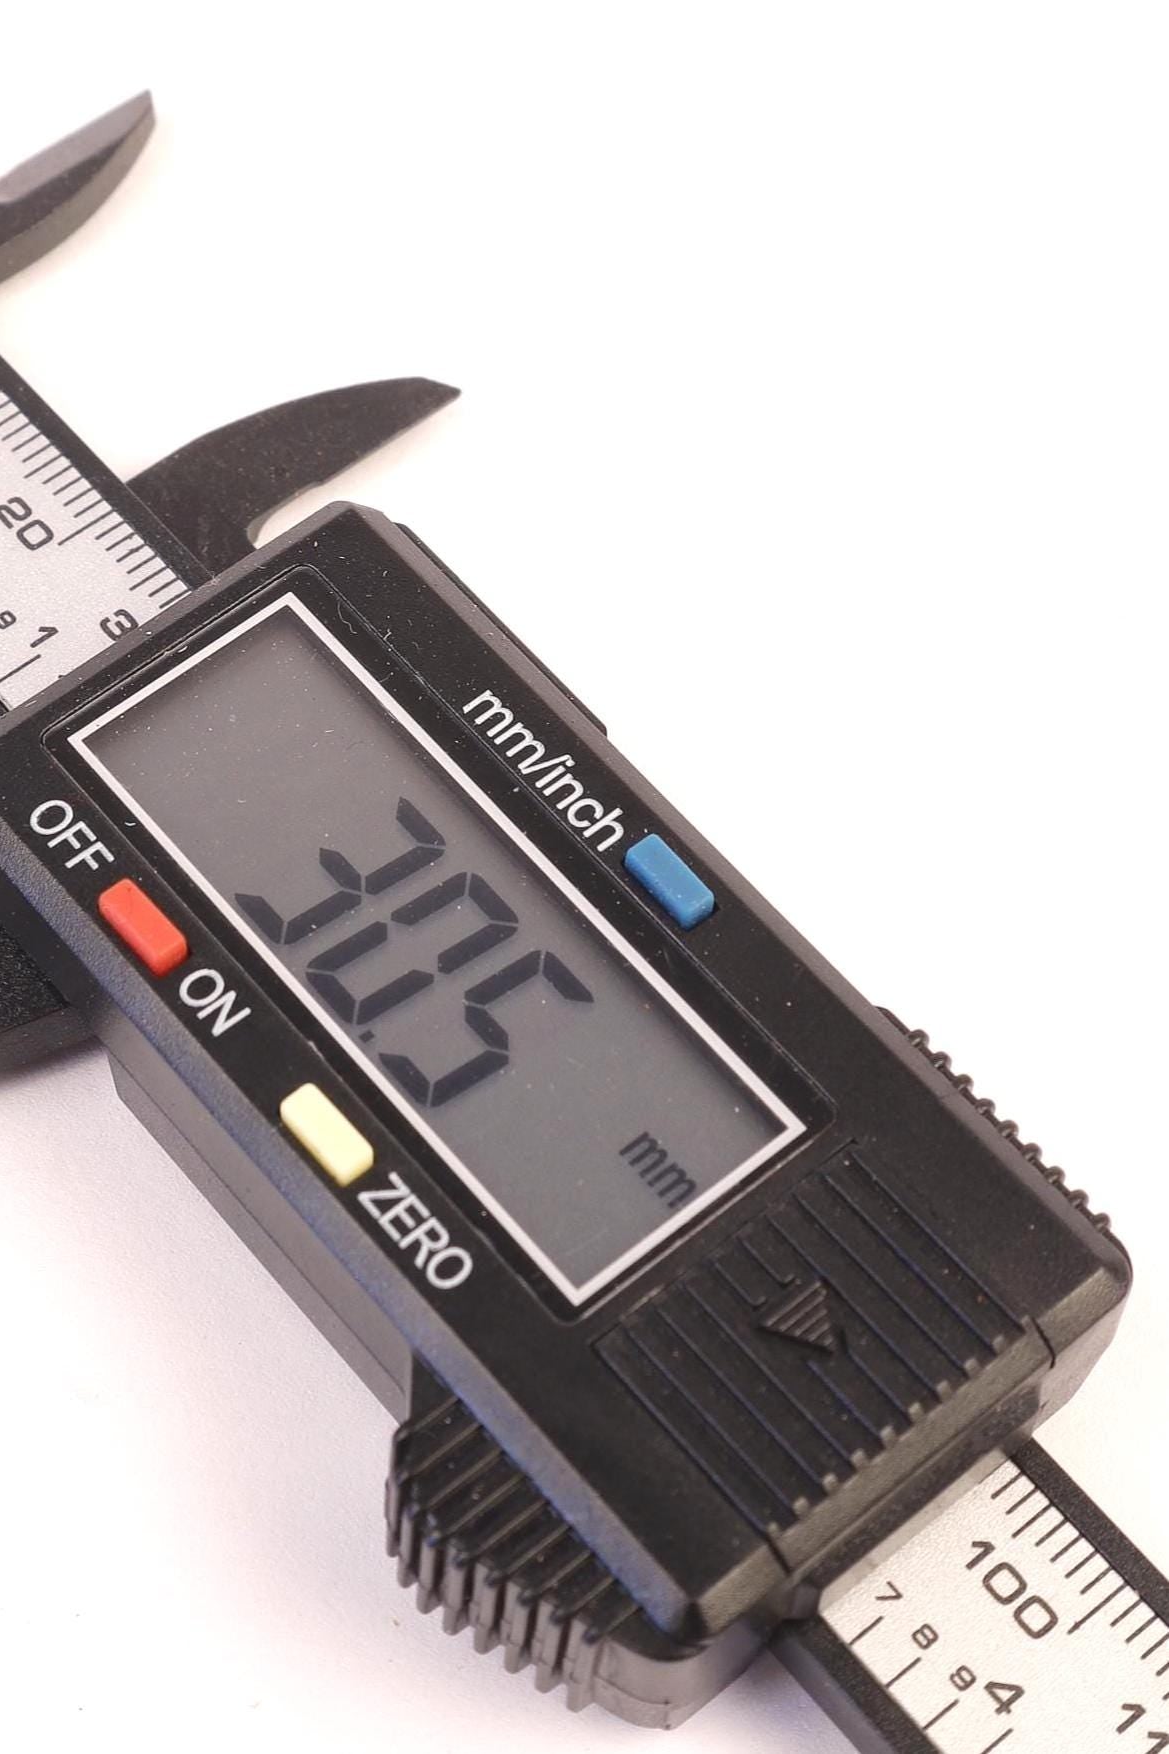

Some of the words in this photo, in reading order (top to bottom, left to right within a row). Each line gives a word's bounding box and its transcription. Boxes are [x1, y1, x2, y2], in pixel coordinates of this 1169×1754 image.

[29, 624, 59, 650] 1
[98, 607, 140, 642] 3
[462, 688, 626, 852] mm/inch
[30, 799, 115, 873] OFF
[178, 968, 251, 1037] ON
[618, 1130, 698, 1209] mm
[357, 1172, 473, 1290] ZERO
[875, 1580, 903, 1602] 7
[965, 1540, 1059, 1640] 100
[912, 1623, 939, 1650] 8
[949, 1665, 977, 1691] 9
[984, 1681, 1025, 1715] 4
